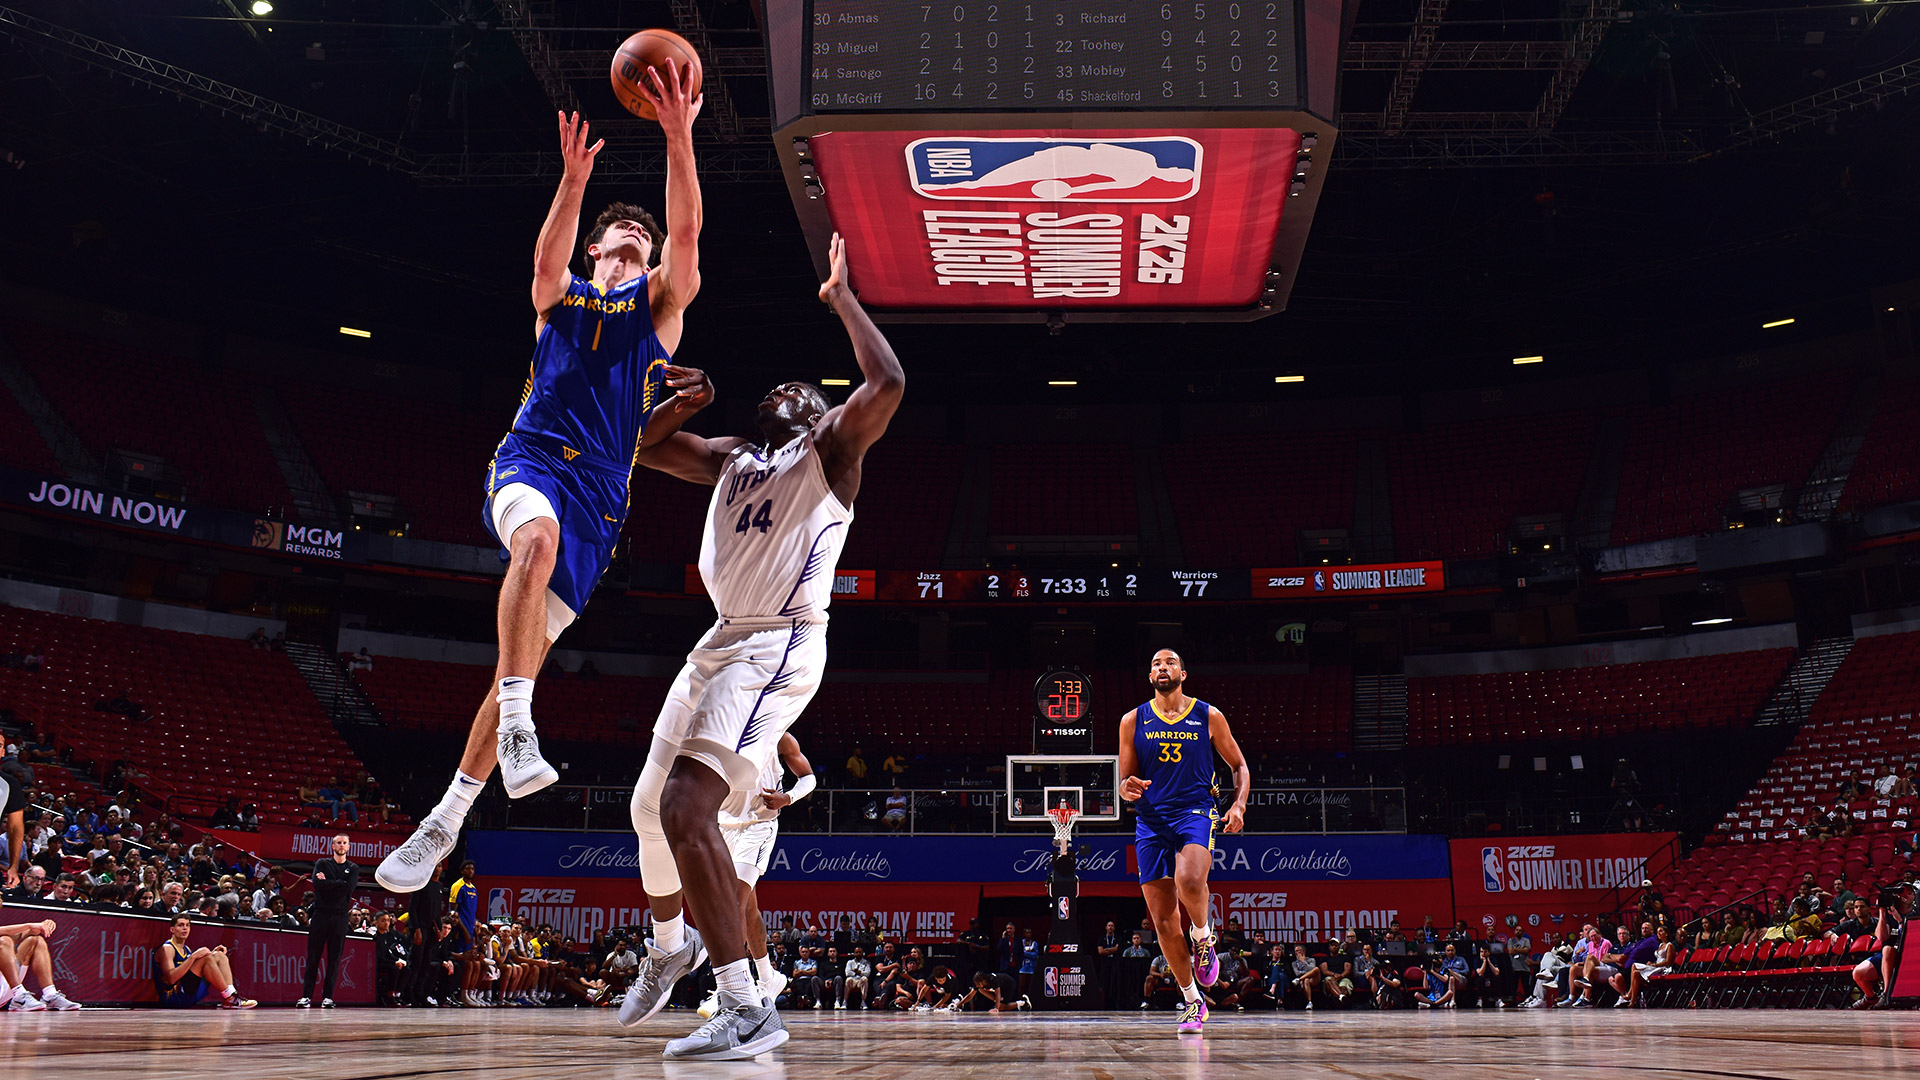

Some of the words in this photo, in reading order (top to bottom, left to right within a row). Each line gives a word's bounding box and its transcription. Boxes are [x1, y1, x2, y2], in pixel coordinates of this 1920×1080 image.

[814, 13, 830, 25] 30
[838, 13, 879, 24] Abmas
[921, 6, 931, 22] 7
[953, 6, 964, 22] 0
[988, 5, 998, 22] 2
[1025, 5, 1034, 21] 1
[1056, 14, 1064, 26] 3
[1080, 13, 1126, 24] Richard
[1161, 4, 1172, 20] 6
[1195, 4, 1205, 20] 5
[1229, 4, 1240, 20] 0
[1265, 4, 1277, 20] 2
[812, 43, 830, 55] 39
[837, 42, 879, 55] Miguel
[920, 33, 931, 49] 2
[954, 33, 963, 49] 1
[987, 32, 998, 48] 0
[1025, 31, 1034, 48] 1
[1055, 41, 1073, 53] 22
[1080, 39, 1125, 52] Toohey
[1161, 30, 1172, 47] 9
[1195, 30, 1206, 46] 4
[1230, 30, 1241, 46] 2
[1266, 30, 1277, 46] 2
[812, 68, 829, 80] 44
[836, 68, 882, 80] Sanogo
[920, 58, 930, 75] 2
[952, 57, 964, 74] 4
[987, 57, 998, 74] 3
[1023, 57, 1035, 74] 2
[1056, 66, 1073, 78] 33
[1080, 65, 1126, 77] Mobley
[1161, 56, 1173, 73] 4
[1196, 55, 1207, 72] 5
[1230, 55, 1242, 72] 0
[1267, 55, 1279, 72] 2
[812, 93, 829, 106] 60
[836, 92, 882, 105] McGriff
[914, 83, 936, 100] 16
[952, 83, 963, 100] 4
[987, 83, 998, 100] 2
[1023, 82, 1034, 99] 5
[1056, 89, 1073, 101] 45
[1080, 90, 1141, 102] Shackelford
[1162, 81, 1173, 98] 8
[1198, 81, 1207, 98] 1
[1233, 81, 1242, 98] 1
[1268, 80, 1279, 98] 3
[926, 148, 973, 178] NBA
[922, 210, 1027, 286] LEAGUE
[1025, 212, 1124, 298] SUMMER
[1138, 213, 1190, 284] 2K26
[563, 294, 636, 314] WARRIORS
[592, 319, 602, 351] 1
[29, 481, 104, 515] JOIN
[111, 496, 186, 529] NOW
[736, 499, 772, 535] 44
[287, 524, 343, 548] MGM
[832, 576, 858, 594] AGUE
[917, 572, 941, 580] Jazz
[987, 575, 999, 589] 2
[1019, 578, 1028, 588] 3
[1100, 578, 1107, 588] 1
[1126, 575, 1137, 588] 2
[1172, 571, 1218, 579] Warriors
[1268, 577, 1305, 587] 2K26
[1332, 570, 1382, 590] SUMMER
[1384, 568, 1426, 588] LEAGUE
[917, 582, 943, 599] 71
[1041, 578, 1087, 594] 7:33
[1179, 581, 1209, 597] 77
[1054, 680, 1082, 694] 7:33
[1048, 694, 1079, 718] 20
[1145, 731, 1199, 741] WARRIORS
[1158, 742, 1183, 763] 33
[595, 790, 634, 803] ULT
[558, 845, 640, 869] Michel
[1507, 845, 1555, 859] 2K26
[801, 848, 891, 878] Courtside
[1260, 848, 1351, 877] Courtside
[1507, 859, 1584, 891] SUMMER
[1586, 857, 1649, 889] LEAGUE
[518, 889, 576, 903] 2K26
[1229, 893, 1287, 908] 2K26
[873, 911, 910, 937] PLAY
[916, 911, 955, 937] HERE
[1049, 944, 1078, 953] 2K26
[1060, 974, 1085, 985] SUMMER
[1060, 986, 1082, 997] LEAGUE
